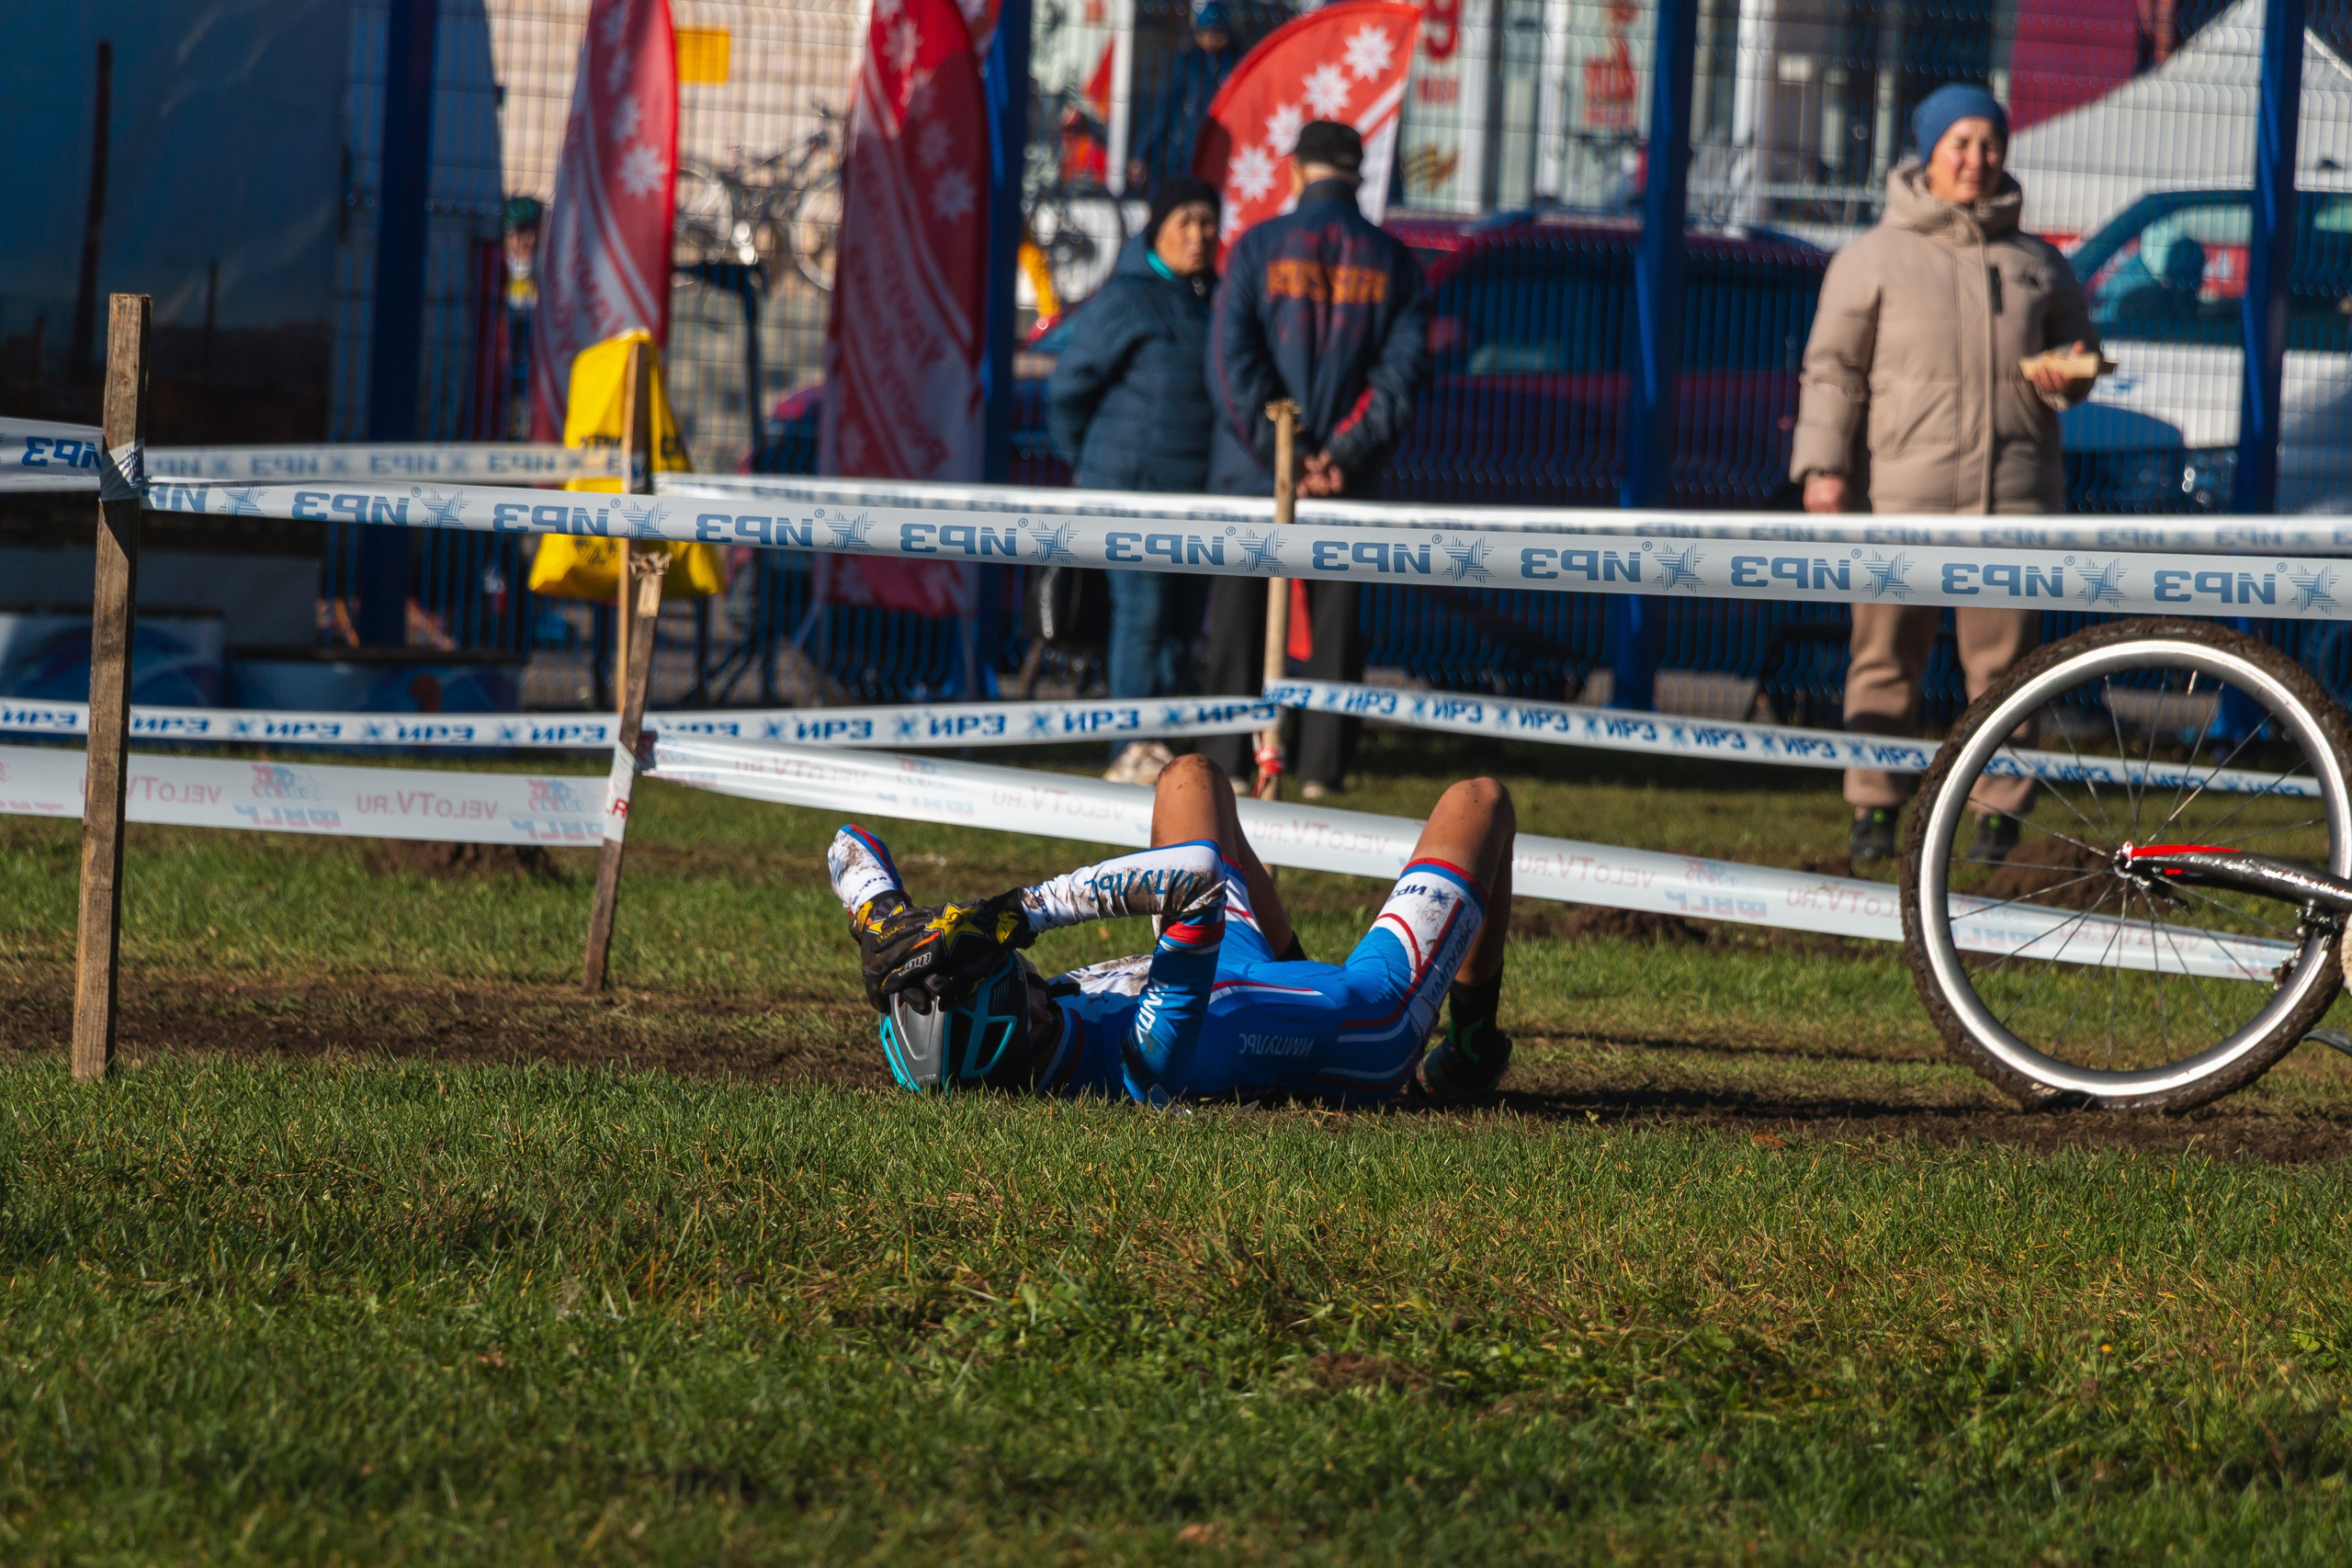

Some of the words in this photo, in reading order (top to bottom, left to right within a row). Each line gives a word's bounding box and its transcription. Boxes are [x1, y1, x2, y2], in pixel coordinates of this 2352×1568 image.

[797, 718, 873, 739] ИРЗ
[930, 712, 1006, 736] ИРЗ
[1064, 708, 1140, 732] ИРЗ
[1238, 1032, 1315, 1058] ИМПУЛЬС
